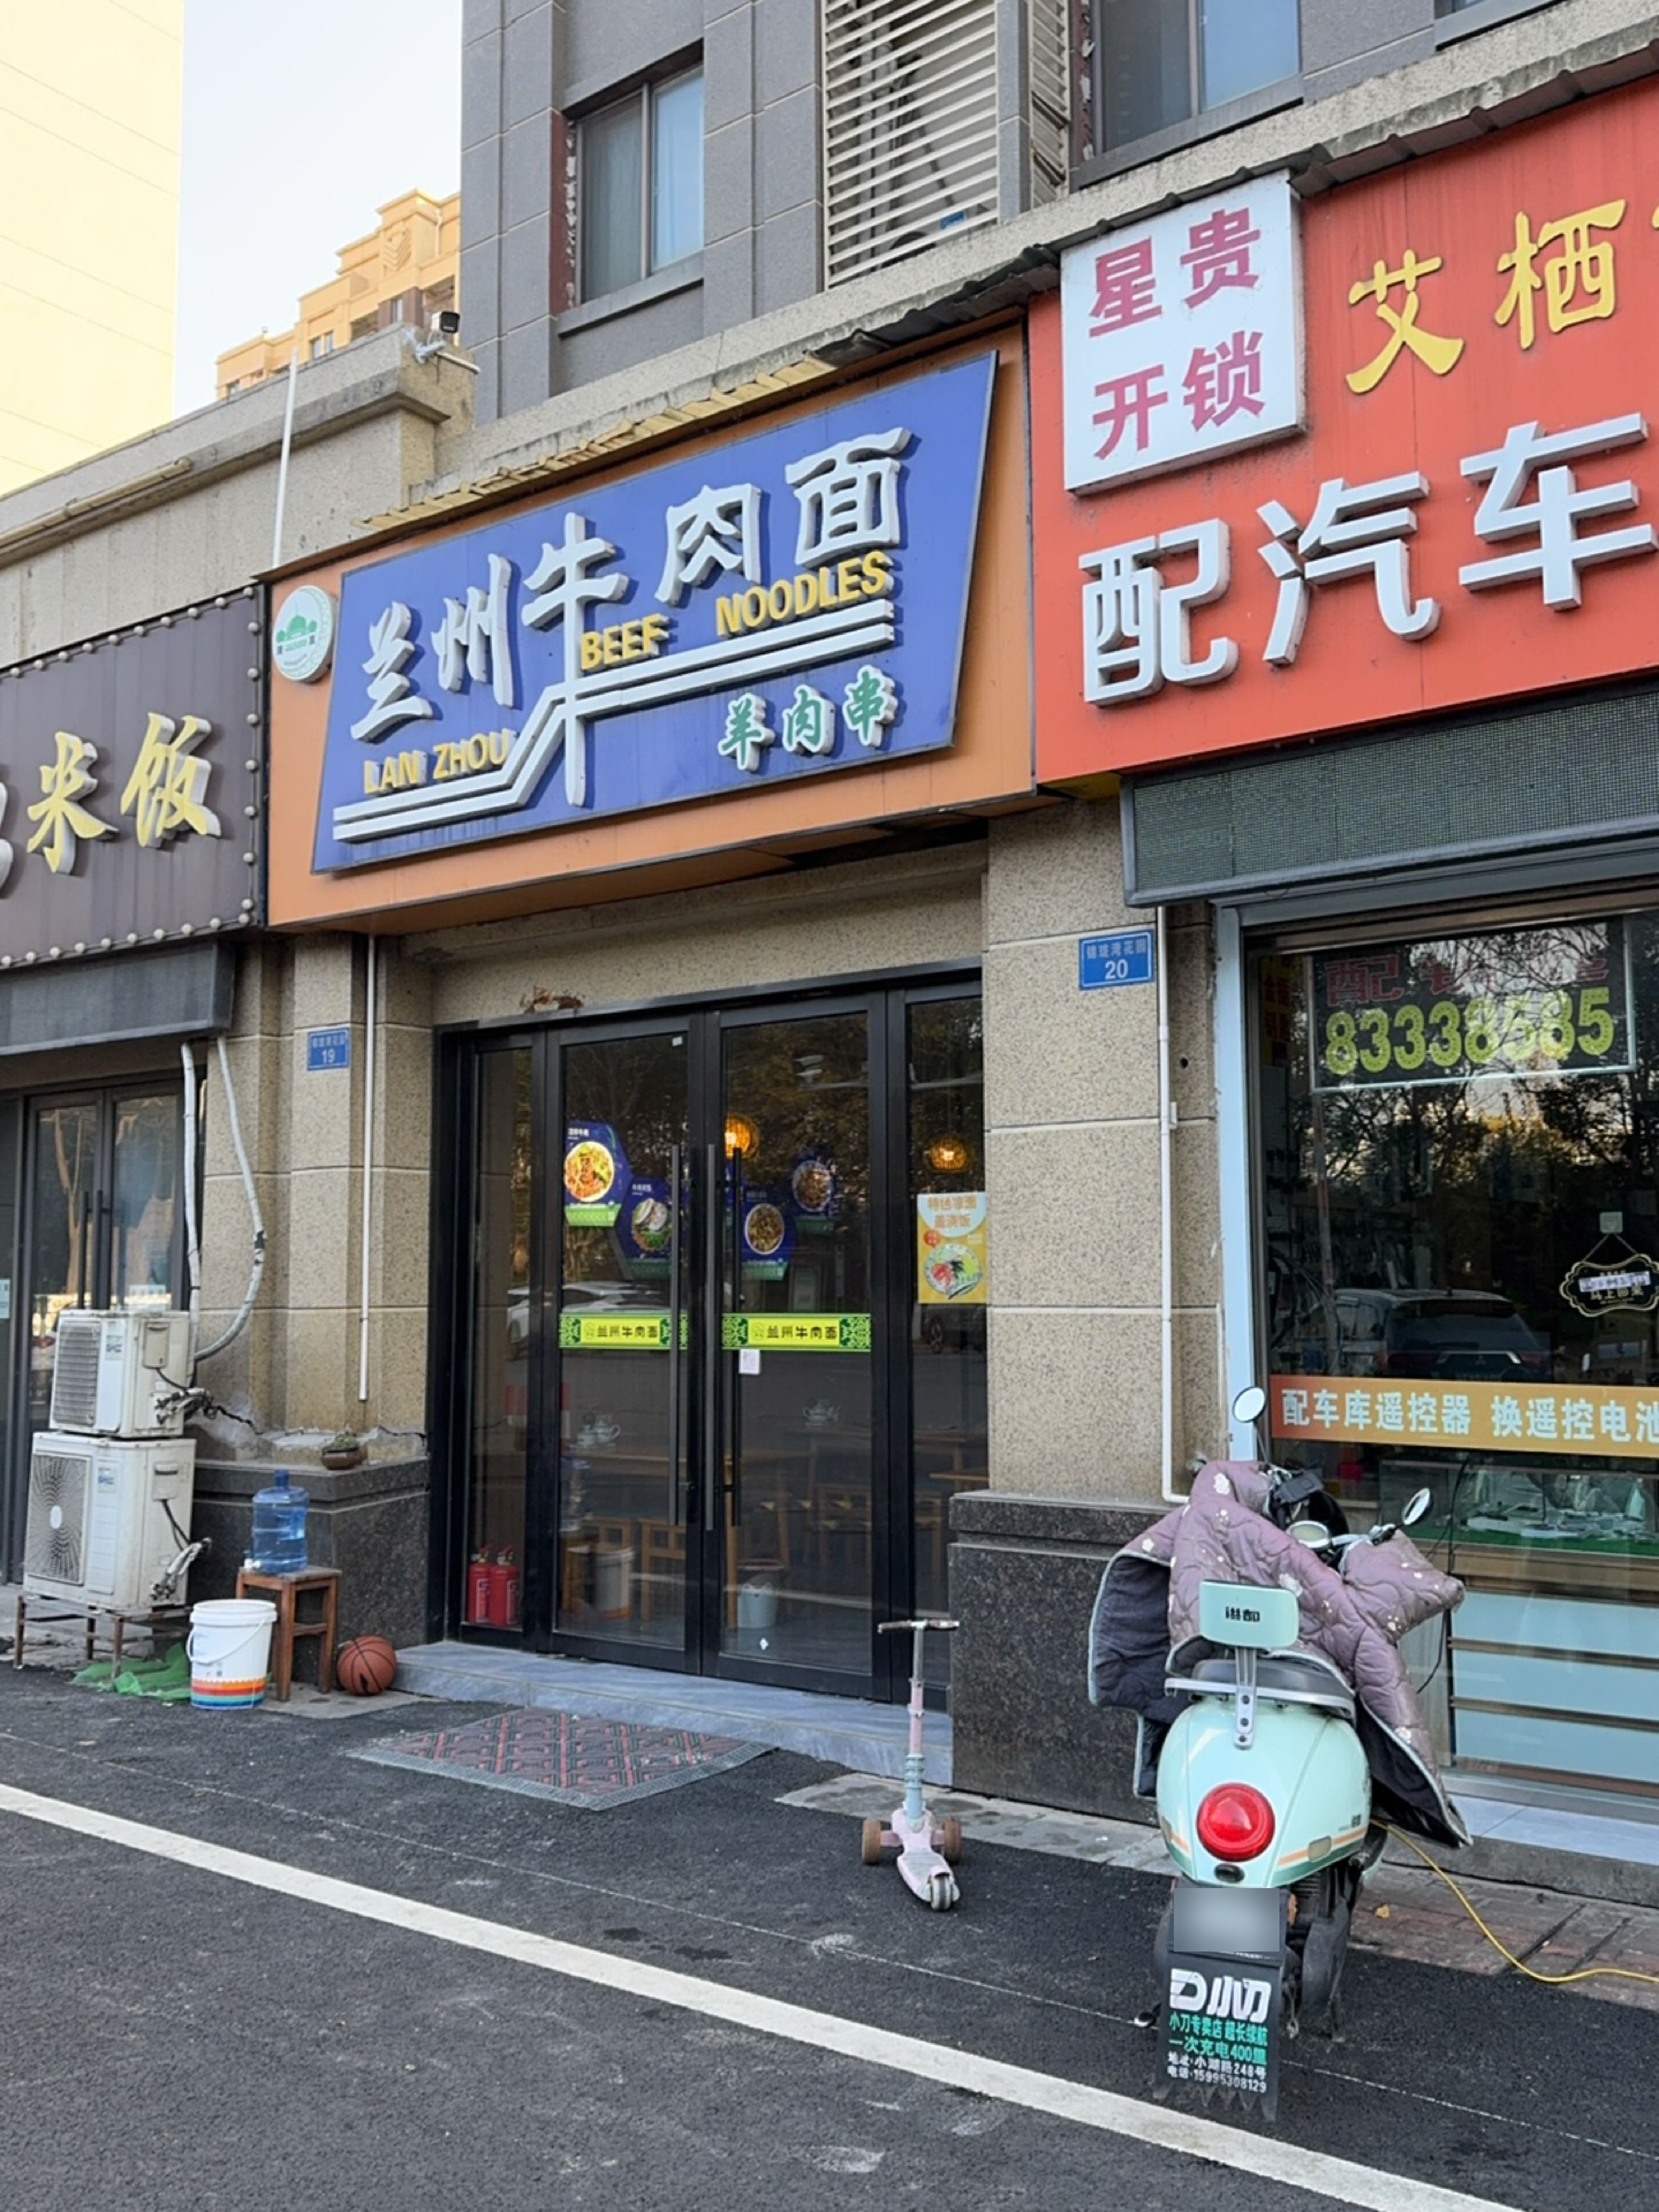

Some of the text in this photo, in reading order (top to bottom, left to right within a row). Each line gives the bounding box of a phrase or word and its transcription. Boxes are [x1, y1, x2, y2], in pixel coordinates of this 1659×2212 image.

[1088, 208, 1260, 337] 星贵
[1345, 199, 1659, 394] 艾栖
[1093, 330, 1265, 460] 开锁
[1079, 412, 1659, 707] 配汽车
[351, 426, 912, 806] 兰州牛肉面
[580, 551, 894, 669] BEEF NOODLES
[364, 728, 517, 794] LAN ZHOU
[717, 664, 898, 771] 羊肉串
[0, 712, 221, 894] 米饭
[1105, 959, 1128, 980] 20
[321, 1049, 336, 1064] 19
[1326, 987, 1614, 1075] 83338585
[597, 1325, 659, 1339] 兰州牛肉面
[766, 1325, 838, 1340] 兰州牛肉面
[1281, 1388, 1659, 1444] 配车库遥控器 换遥控电池
[1169, 2011, 1222, 2039] 小刀专卖店
